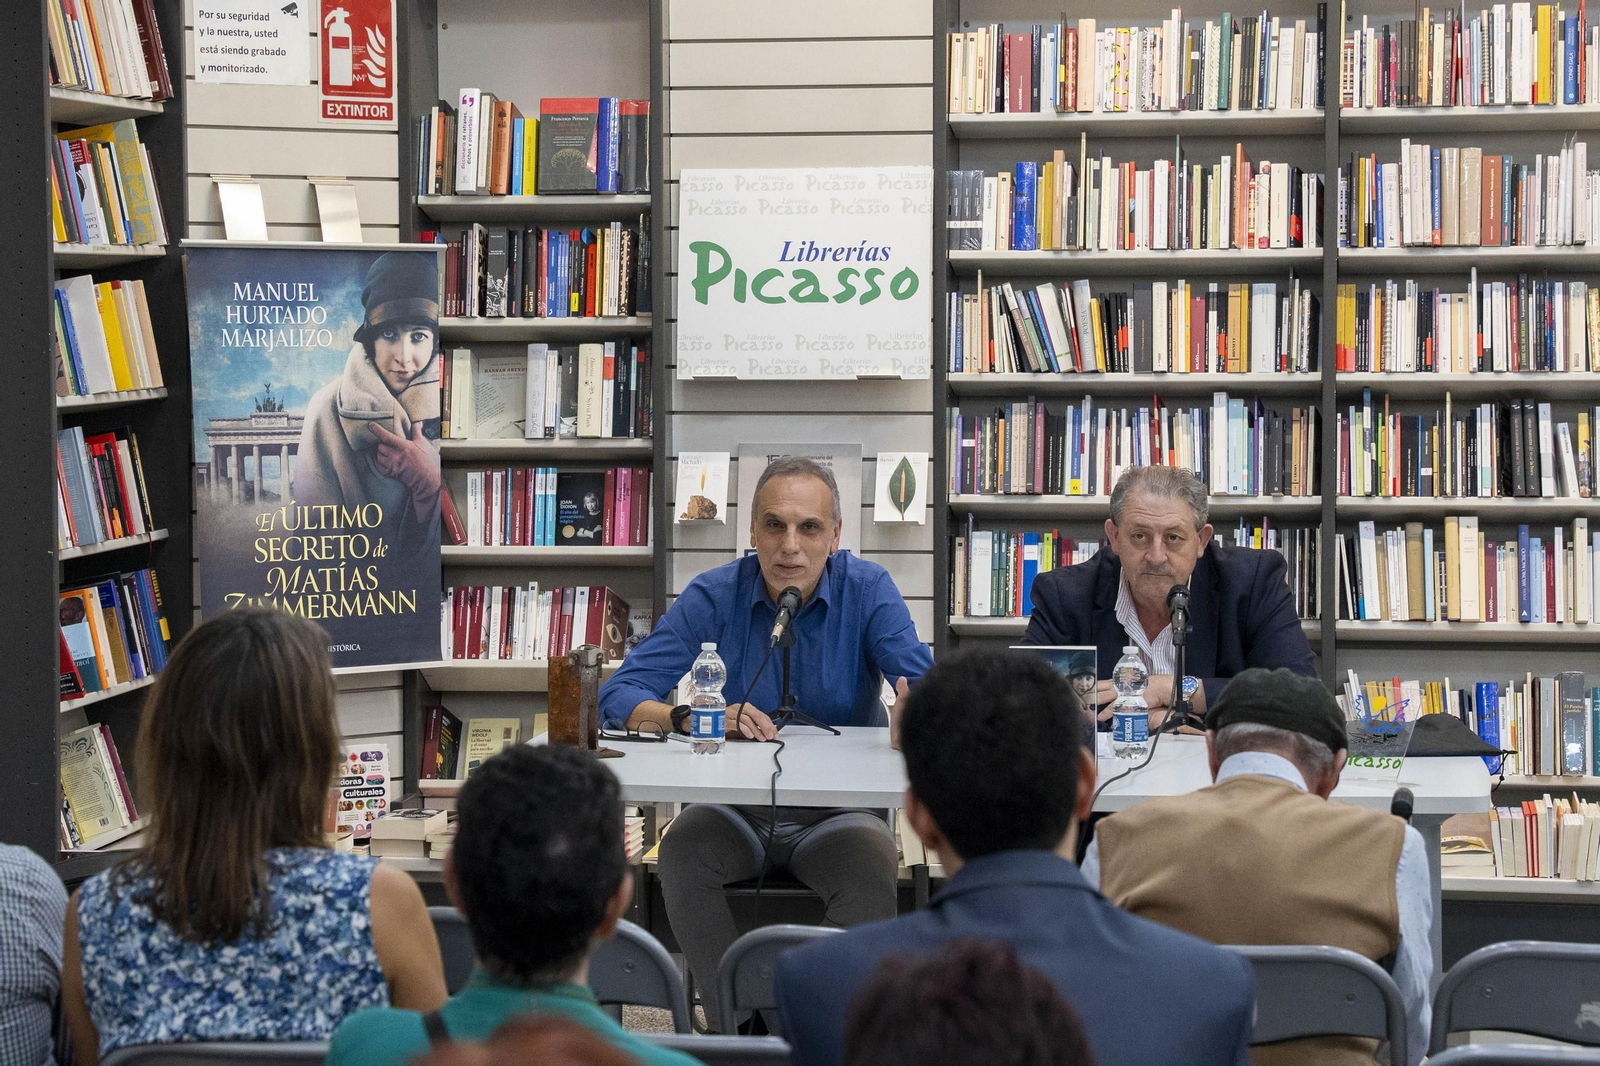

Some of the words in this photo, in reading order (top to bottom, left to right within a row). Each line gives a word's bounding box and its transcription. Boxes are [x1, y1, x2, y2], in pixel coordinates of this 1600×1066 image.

[198, 10, 214, 19] Por
[228, 12, 270, 22] seguridad
[199, 28, 204, 37] y
[206, 27, 215, 36] la
[217, 28, 252, 38] nuestra,
[254, 29, 278, 38] usted
[200, 45, 218, 54] está
[220, 46, 249, 55] siendo
[251, 47, 286, 57] grabado
[200, 65, 206, 73] y
[208, 64, 268, 74] monitorizado.
[326, 103, 388, 117] EXTINTOR
[734, 175, 794, 193] Picasso
[806, 174, 866, 192] Picasso
[687, 199, 747, 216] Picasso
[759, 198, 818, 216] Picasso
[830, 198, 890, 215] Picasso
[778, 240, 891, 263] Librerías
[689, 241, 919, 306] Picasso
[233, 282, 319, 302] MANUEL
[226, 306, 327, 325] HURTADO
[1080, 310, 1090, 334] POESÍA
[221, 328, 333, 352] MARJALIZO
[723, 334, 783, 352] Picasso
[795, 334, 855, 351] Picasso
[866, 333, 926, 351] Picasso
[678, 358, 736, 375] Picasso
[748, 358, 808, 375] Picasso
[819, 358, 880, 375] Picasso
[255, 510, 282, 532] El
[281, 500, 383, 531] ÚLTIMO
[254, 534, 370, 563] SECRETO
[372, 538, 389, 558] de
[265, 562, 379, 598] MATÍAS
[224, 590, 416, 619] ZMERMANN
[1348, 754, 1401, 769] icasso
[345, 788, 384, 797] culturales
